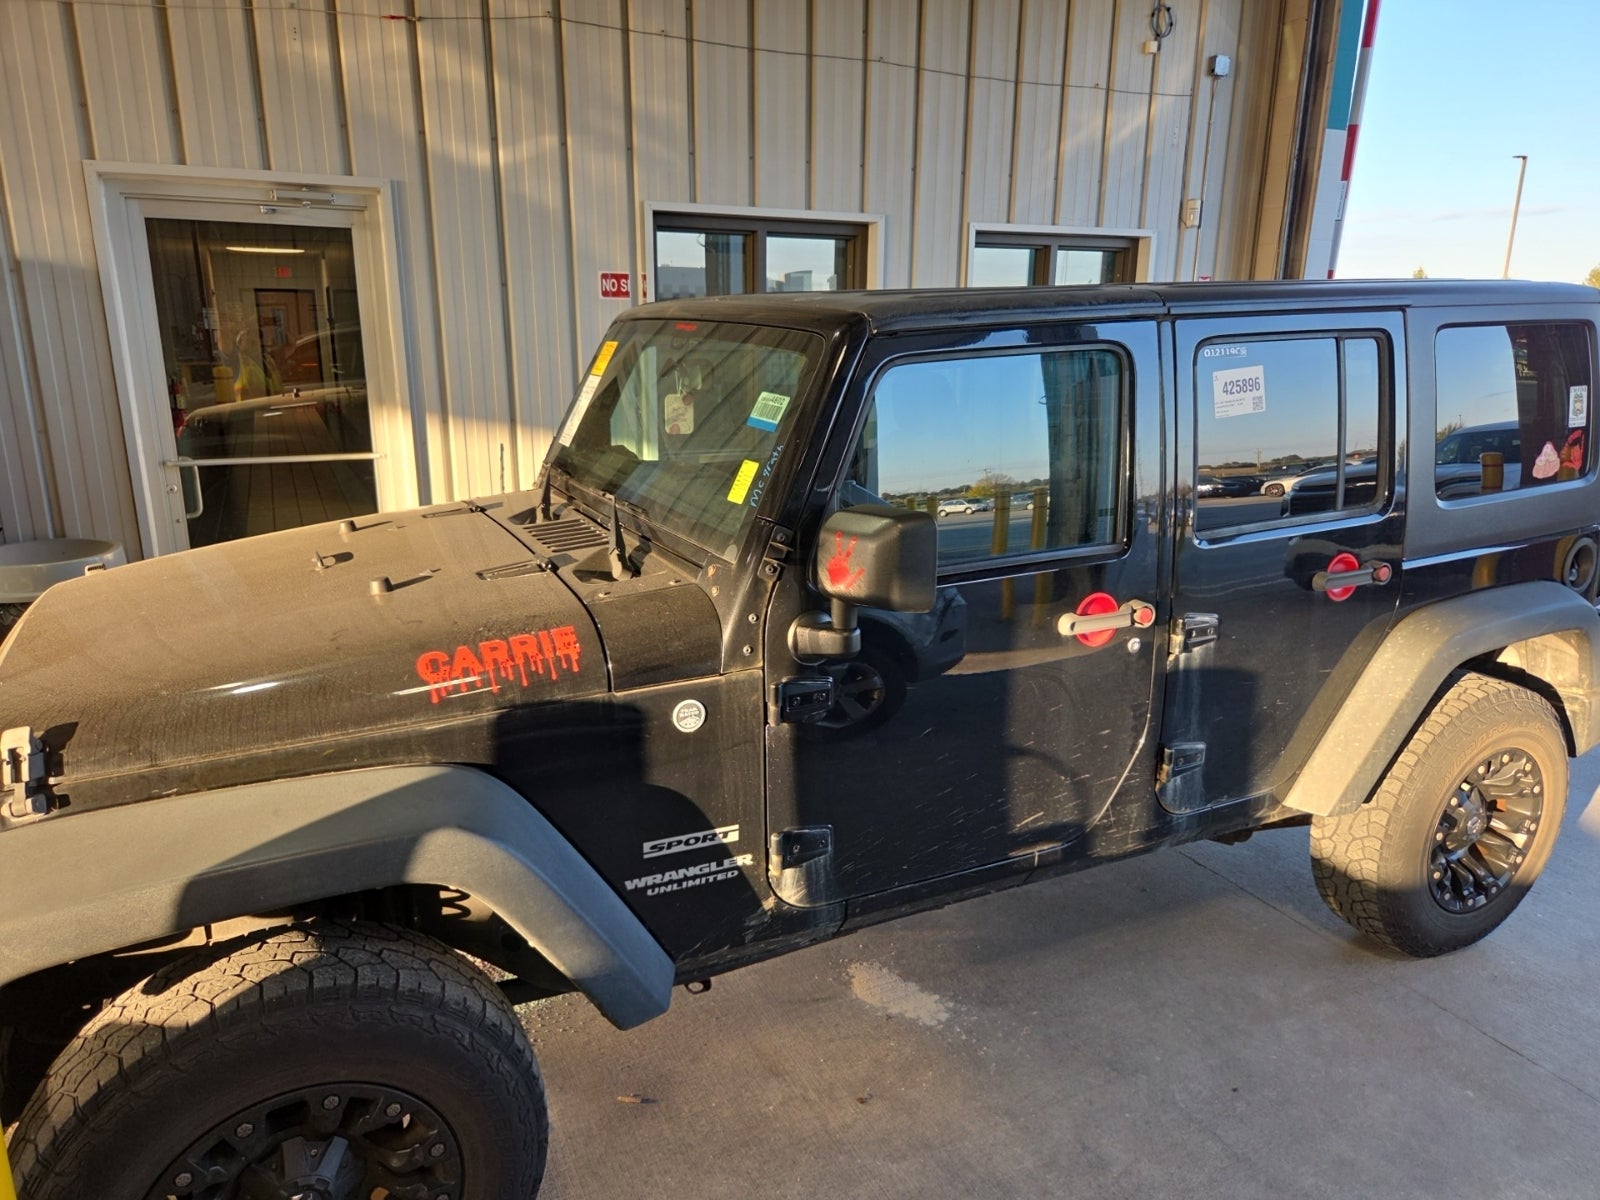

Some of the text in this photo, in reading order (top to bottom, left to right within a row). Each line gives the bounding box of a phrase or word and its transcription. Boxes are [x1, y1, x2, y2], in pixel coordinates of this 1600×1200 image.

[602, 278, 618, 292] NO
[1222, 377, 1261, 396] 425896
[416, 625, 582, 703] CARRIE
[648, 830, 731, 853] SPORT
[624, 853, 753, 891] WRANGLER
[646, 869, 739, 896] UNLIMITED
